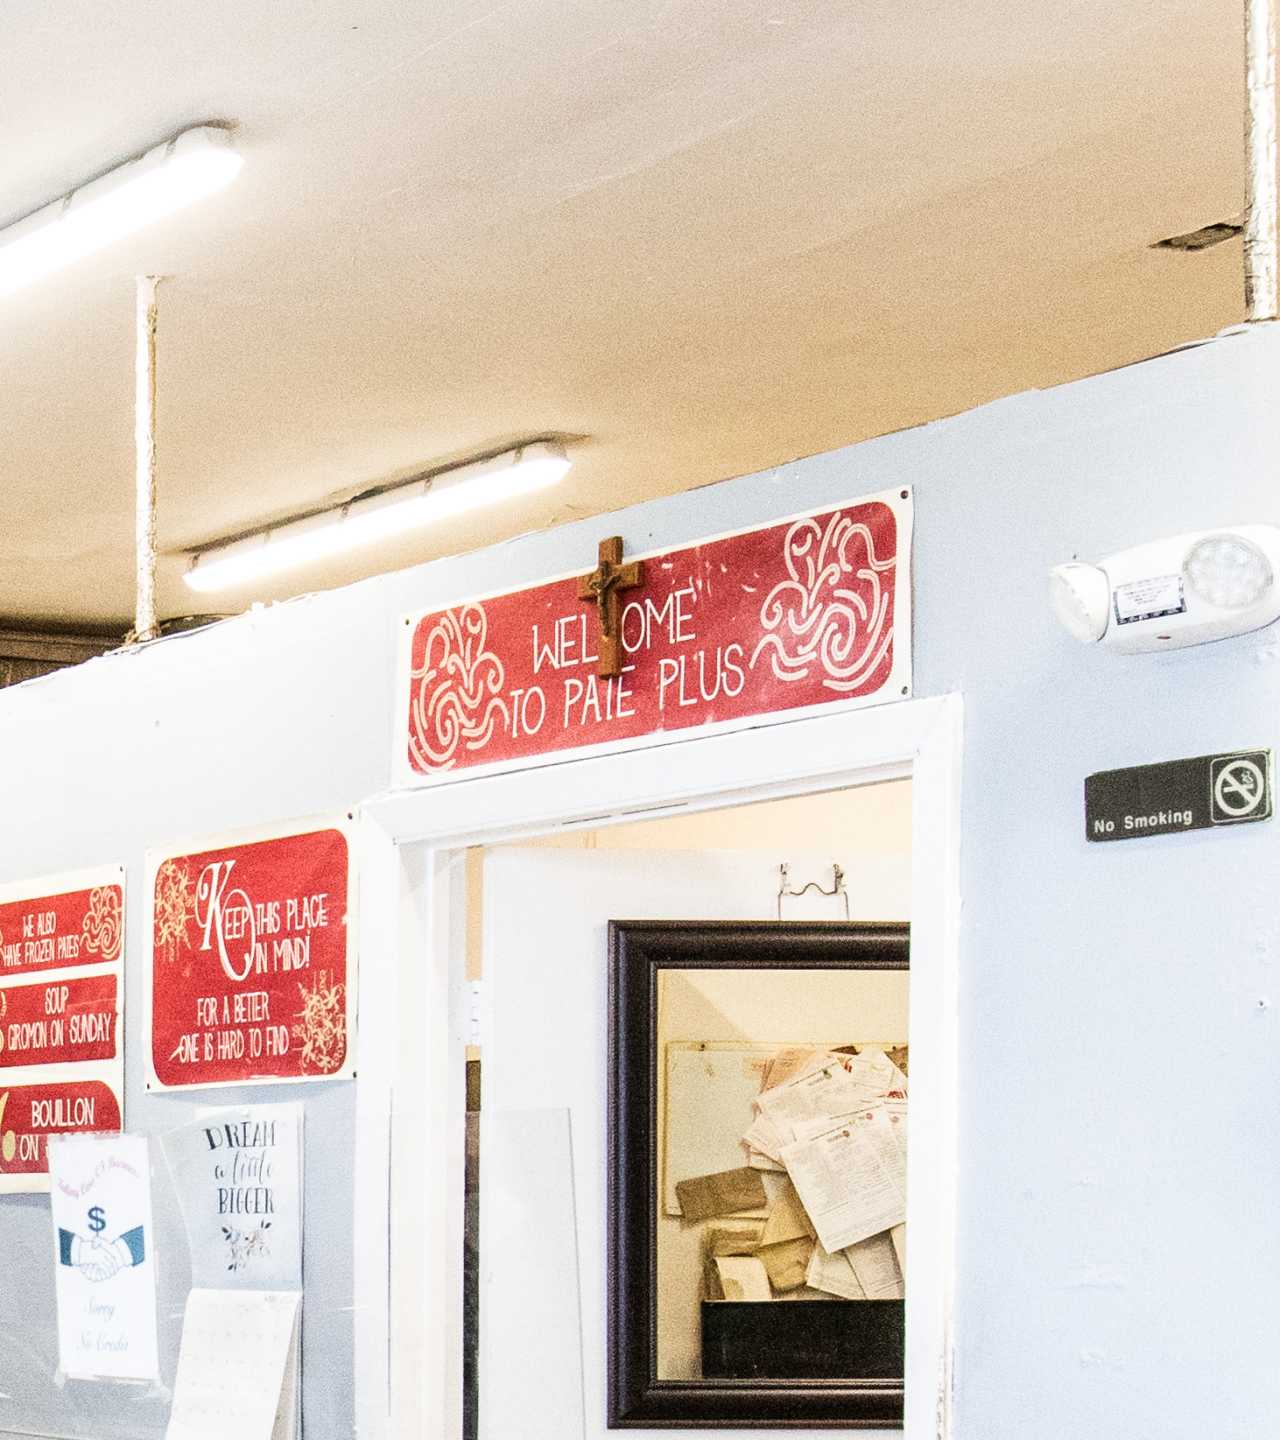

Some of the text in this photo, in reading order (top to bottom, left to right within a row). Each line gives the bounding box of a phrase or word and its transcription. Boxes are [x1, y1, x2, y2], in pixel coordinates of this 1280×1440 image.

[532, 586, 696, 674] WELOME
[510, 686, 546, 738] TO
[659, 643, 745, 710] PLUS
[1094, 810, 1193, 833] No Smoking
[23, 911, 57, 938] WE ALSO
[256, 902, 281, 935] THIS
[287, 894, 328, 931] PLACE
[3, 943, 22, 967] HAVE
[25, 938, 56, 964] FROZEN
[255, 934, 311, 974] IN MIND!
[45, 986, 69, 1015] SOUP
[197, 992, 270, 1026] FOR A BETTER
[51, 1019, 65, 1047] ON
[70, 1013, 112, 1044] SUNDAY
[178, 1025, 289, 1063] ONE IS HARD TO FIND
[31, 1097, 95, 1127] BOUILLON
[20, 1134, 39, 1161] ON
[202, 1120, 276, 1151] DREAM
[217, 1187, 274, 1214] BIGGER
